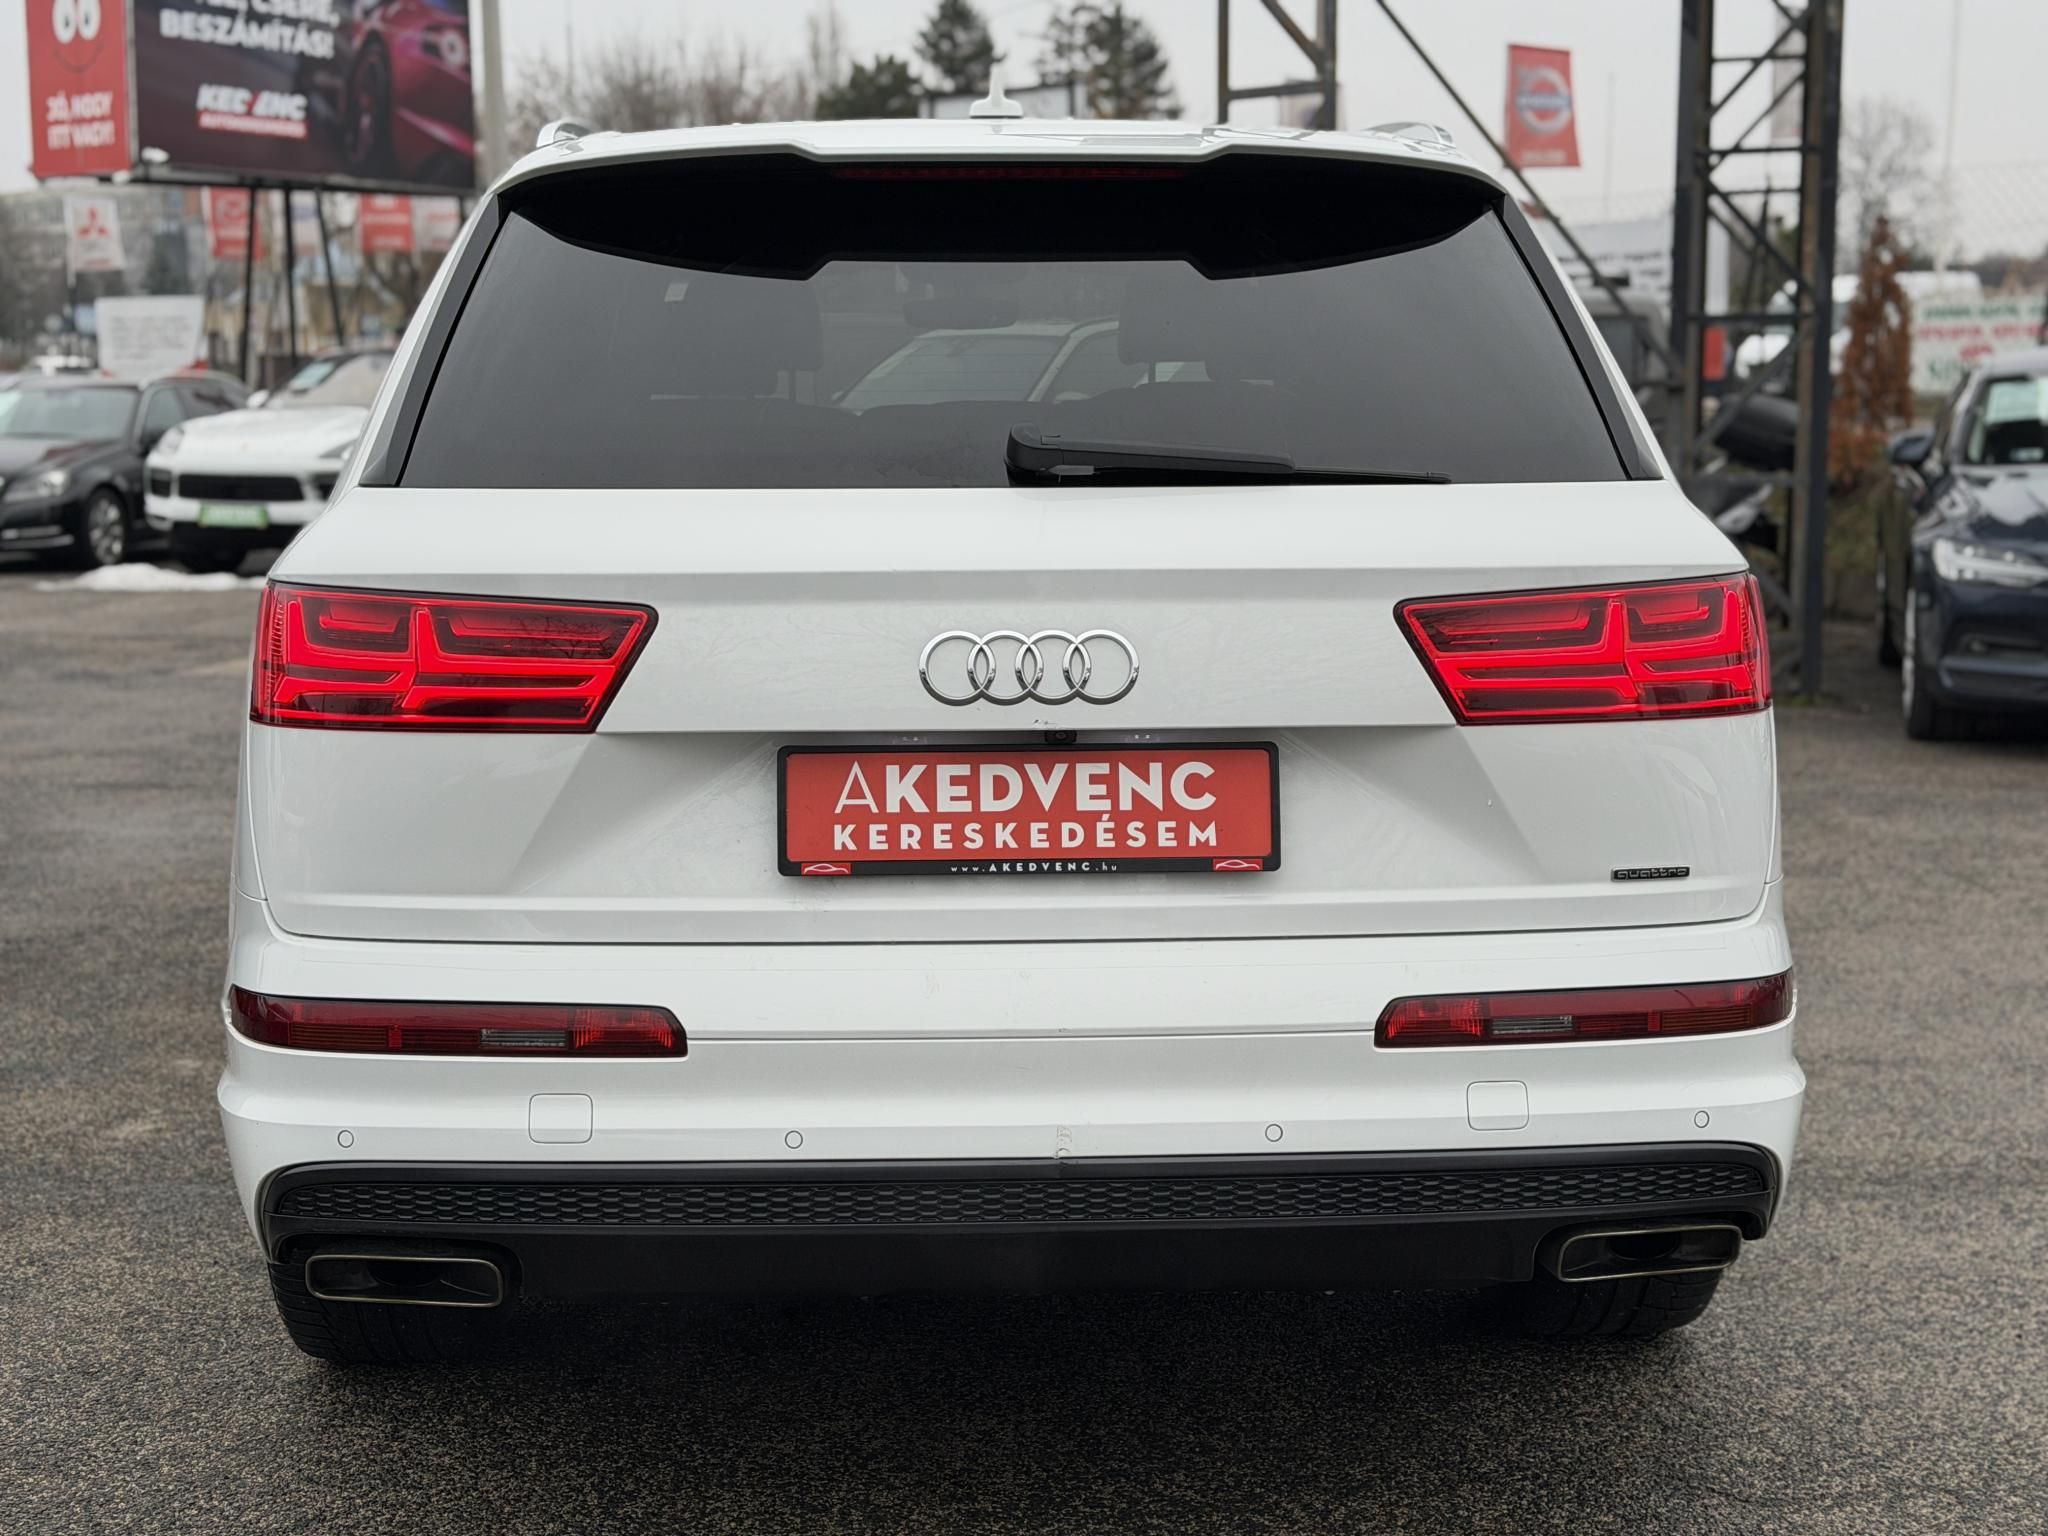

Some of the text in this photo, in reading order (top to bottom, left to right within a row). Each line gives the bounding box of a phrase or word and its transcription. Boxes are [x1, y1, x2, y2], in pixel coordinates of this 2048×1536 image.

[833, 814, 1218, 851] KERESKEDÉSEM
[951, 862, 1117, 873] www.AKEDVENC.hu
[1617, 867, 1687, 880] quattro
